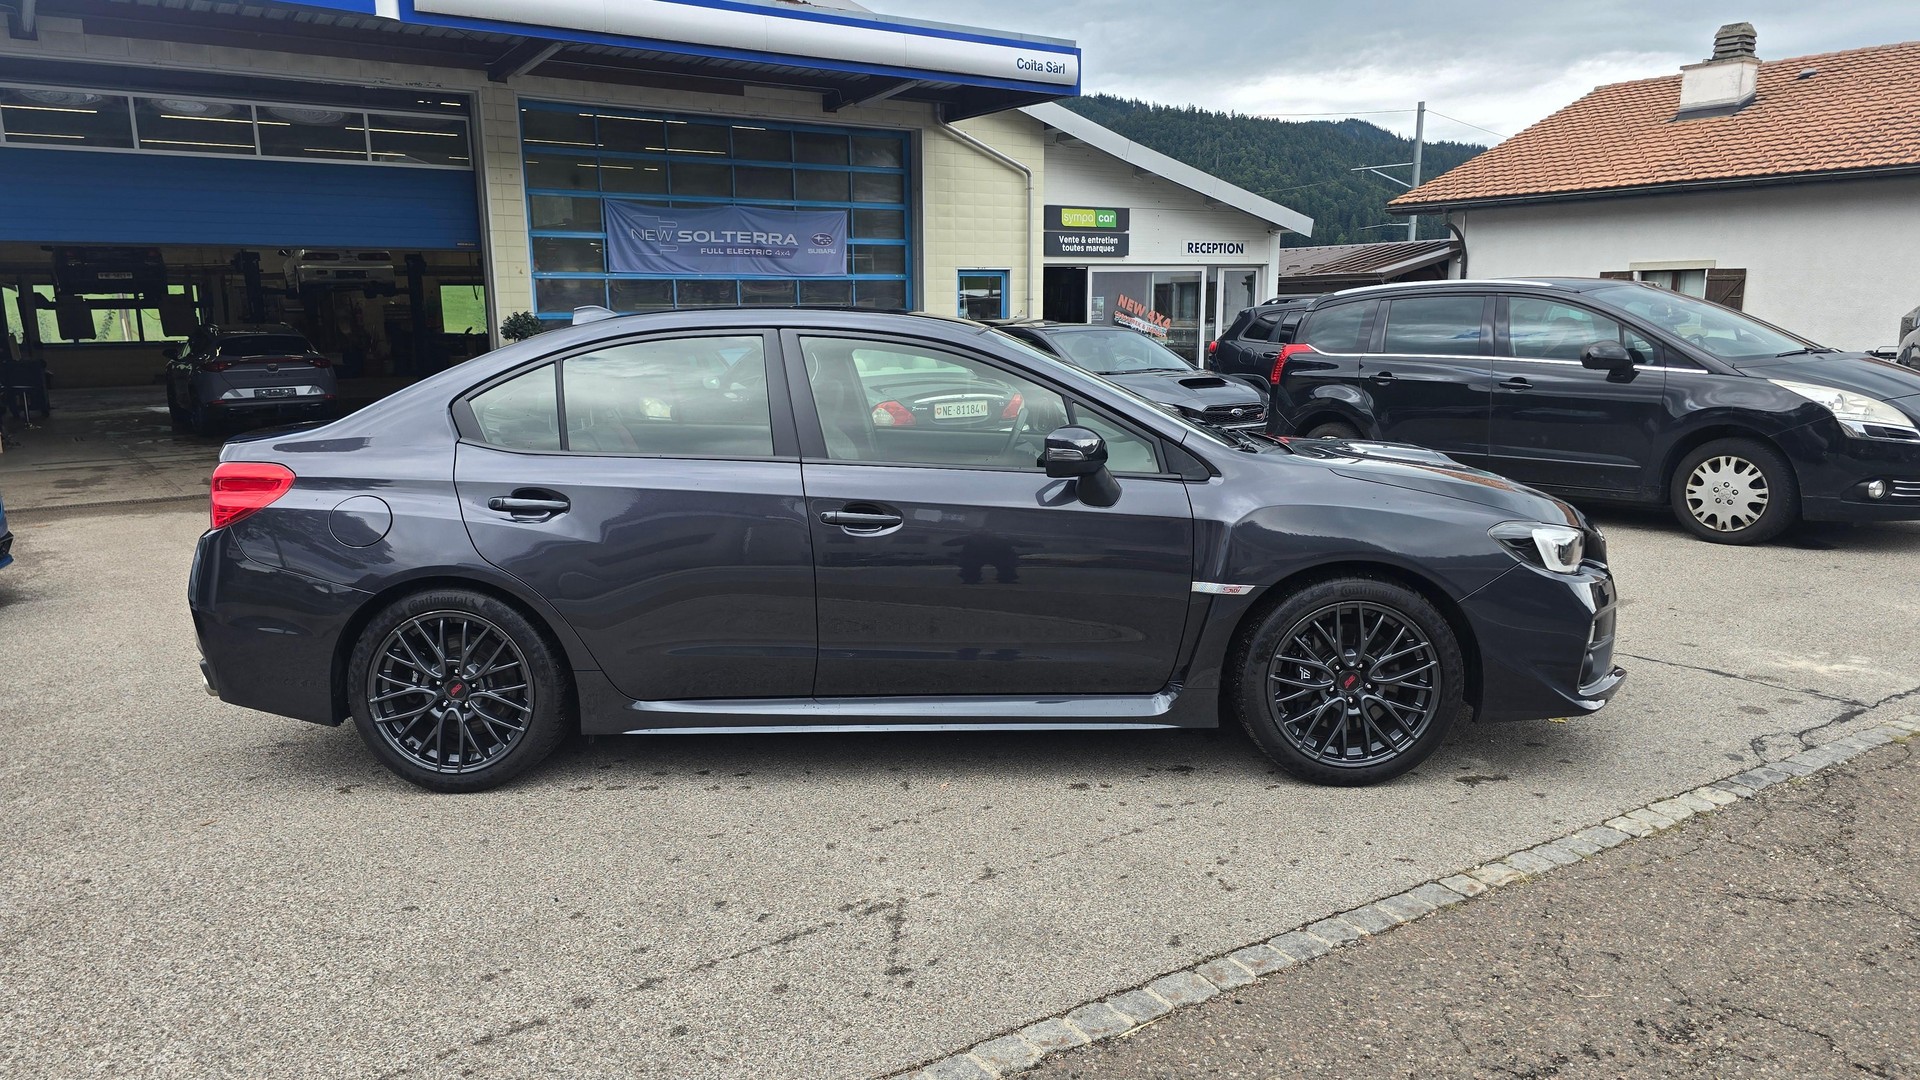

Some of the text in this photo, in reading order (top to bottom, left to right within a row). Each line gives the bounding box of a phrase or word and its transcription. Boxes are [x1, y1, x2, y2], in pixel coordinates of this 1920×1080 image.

[1016, 57, 1066, 75] Coita Sàrl
[1098, 214, 1115, 224] car
[631, 228, 799, 246] NEW SOLTERRA
[1058, 235, 1119, 245] Vente & entretien
[700, 247, 791, 257] FULL ELECTRIC 4x4
[1062, 243, 1115, 254] toutes marques
[1187, 242, 1244, 254] RECEPTION
[1117, 293, 1147, 317] NEW
[1147, 310, 1172, 331] 4X4
